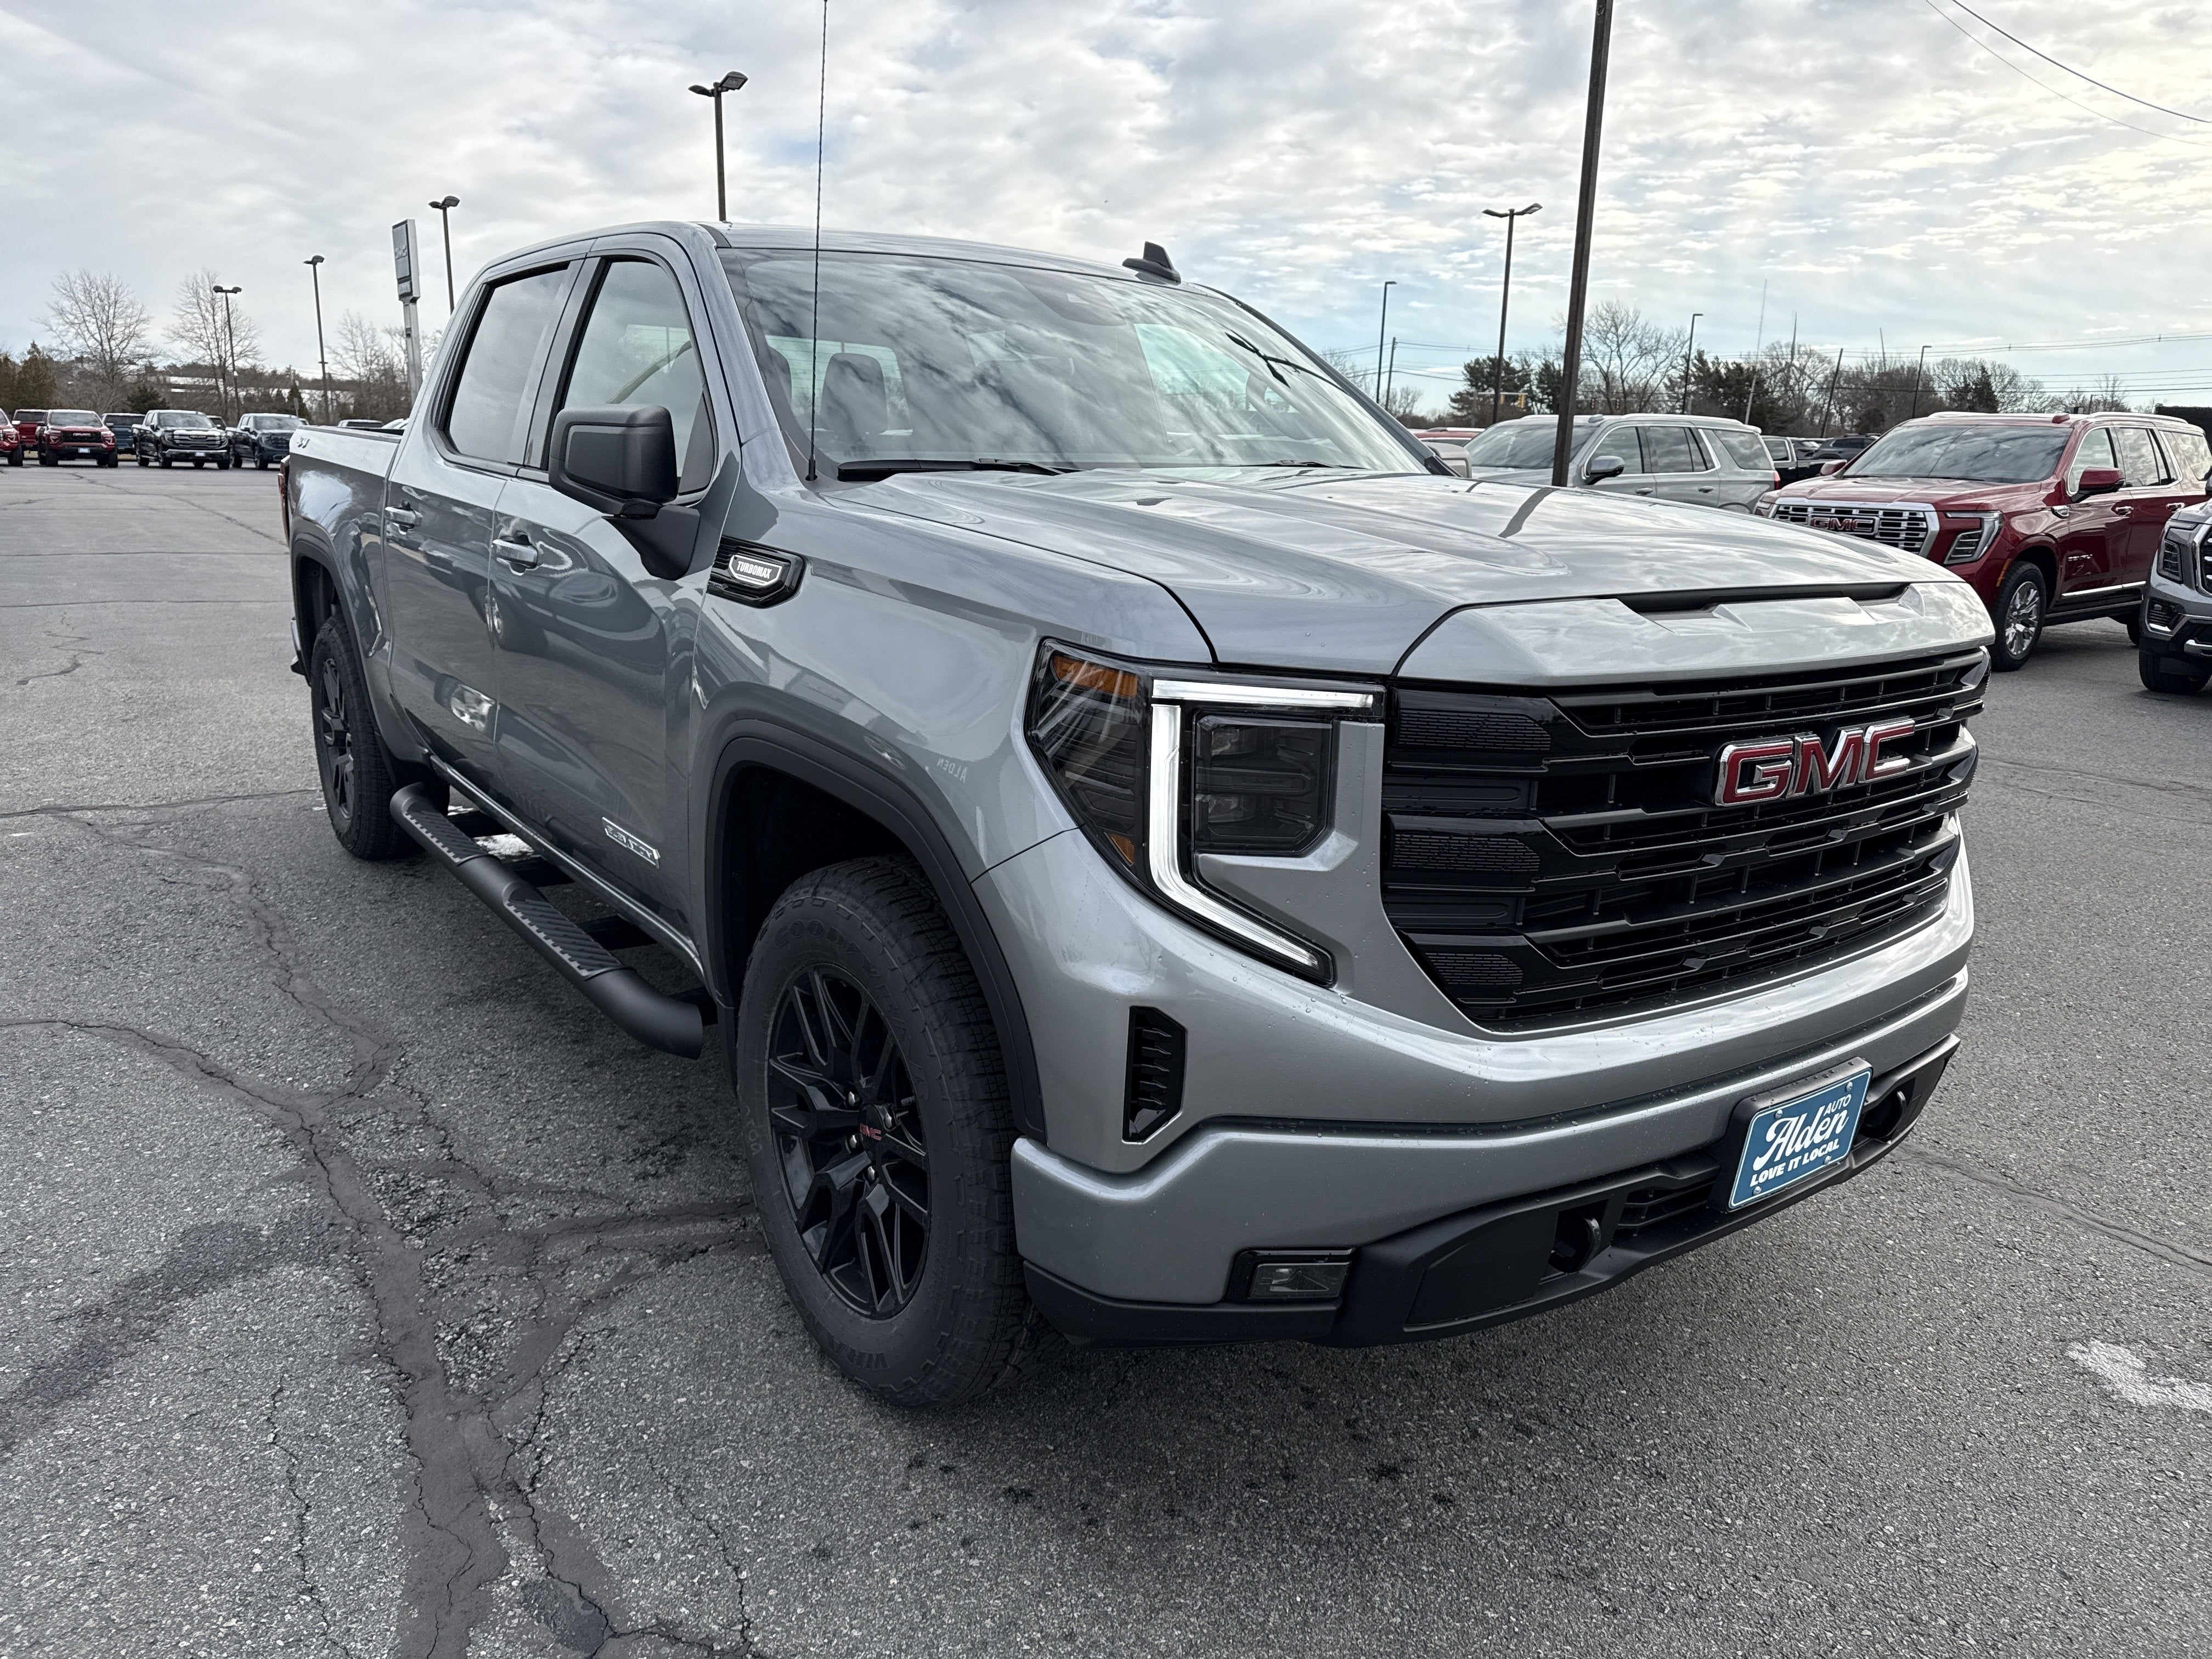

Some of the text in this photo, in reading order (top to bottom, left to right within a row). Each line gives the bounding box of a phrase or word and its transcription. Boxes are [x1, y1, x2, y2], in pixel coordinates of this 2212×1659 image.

[1811, 517, 1874, 532] GMC
[737, 561, 772, 579] TURBOMAX
[1715, 716, 1915, 806] GMC
[1824, 1094, 1852, 1116] AUTO
[860, 1122, 882, 1141] GMC
[1753, 1106, 1849, 1170] Alden
[1750, 1138, 1839, 1187] LOVE IT LOCAL
